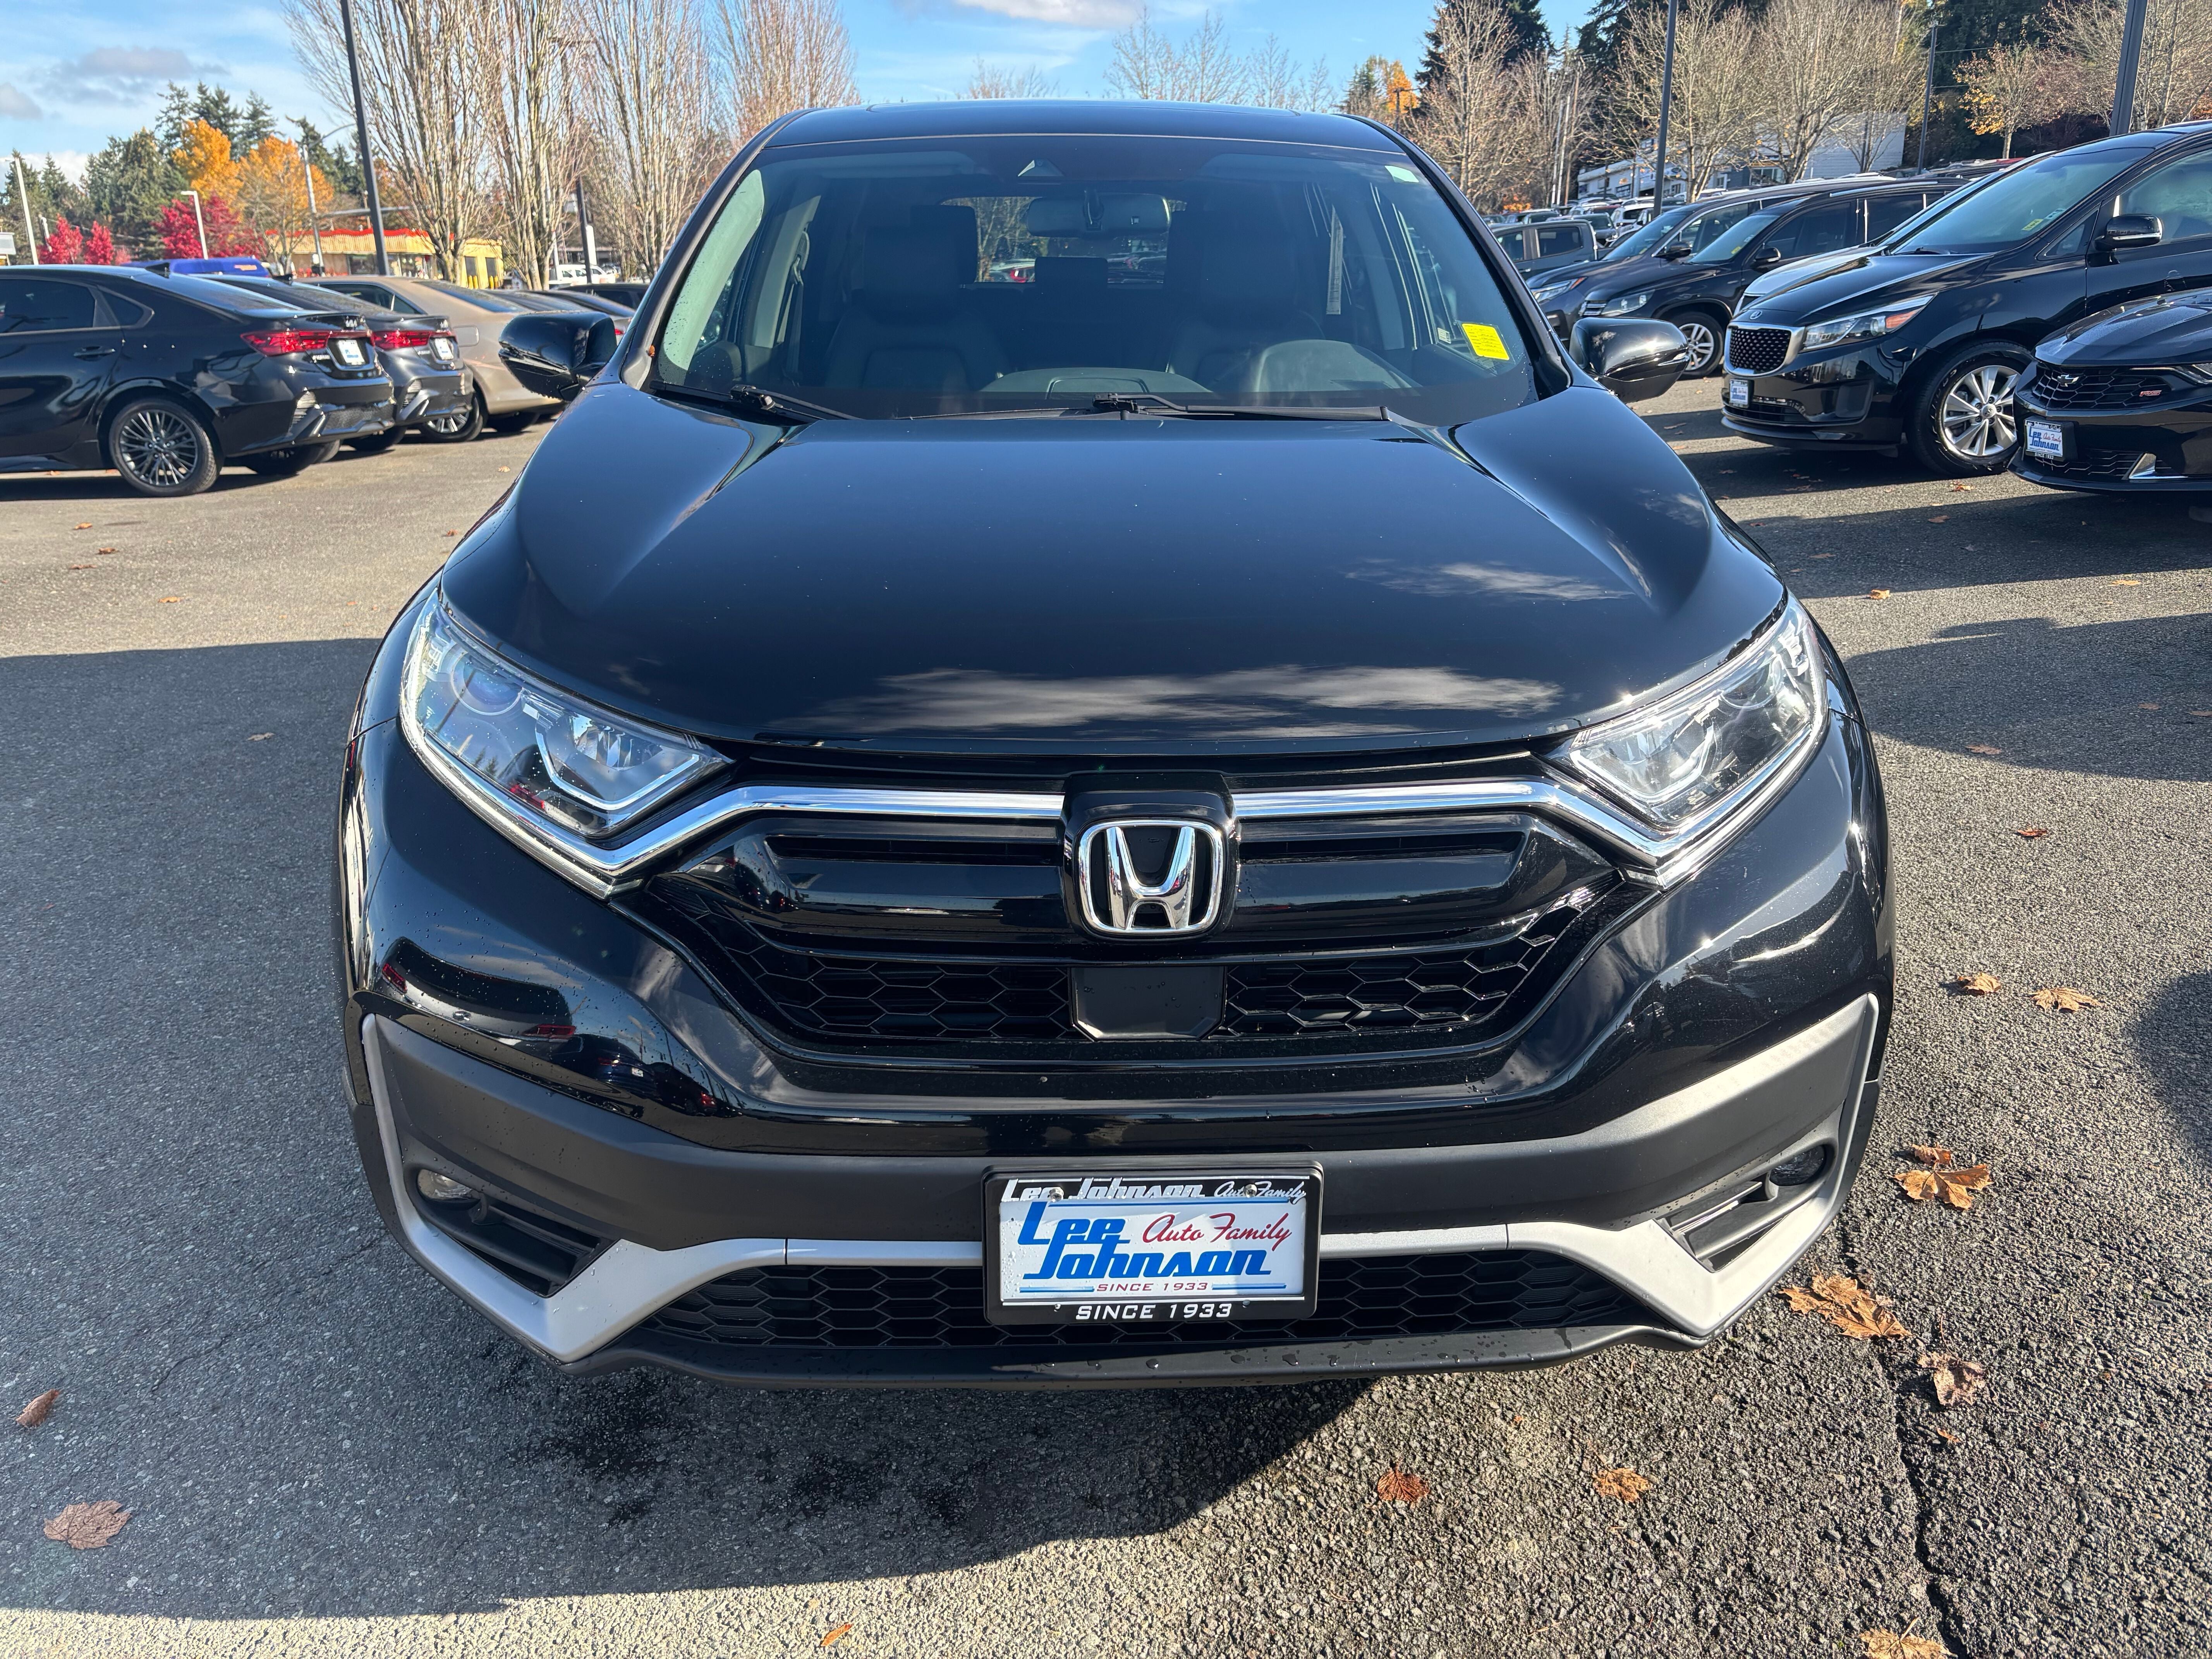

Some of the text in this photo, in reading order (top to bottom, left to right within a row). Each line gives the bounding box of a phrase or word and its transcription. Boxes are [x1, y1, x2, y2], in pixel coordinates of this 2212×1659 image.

[2029, 426, 2041, 438] Lee
[2030, 437, 2059, 451] Johnson
[1068, 1177, 1205, 1199] Johnson
[1214, 1181, 1252, 1197] Aut
[1255, 1181, 1306, 1204] Family
[1017, 1201, 1292, 1251] Lee Auto Family
[1023, 1237, 1271, 1279] Johnson
[1096, 1282, 1209, 1292] SINCE 1933
[1075, 1303, 1232, 1320] SINCE 1933
